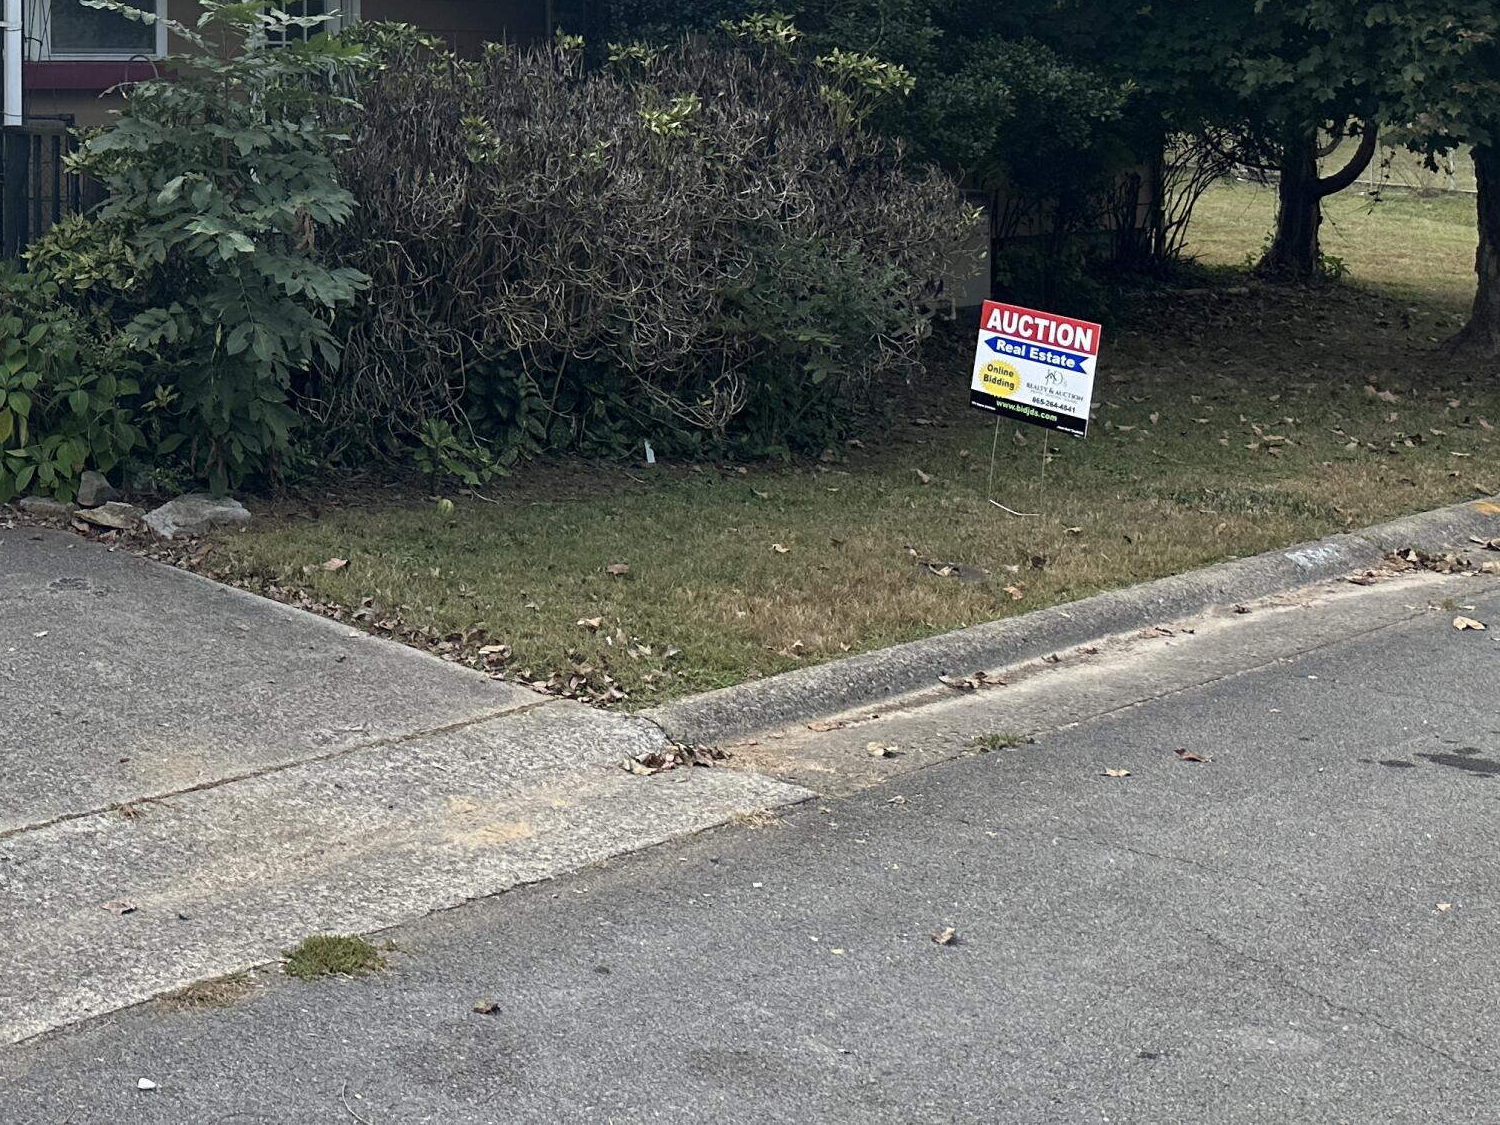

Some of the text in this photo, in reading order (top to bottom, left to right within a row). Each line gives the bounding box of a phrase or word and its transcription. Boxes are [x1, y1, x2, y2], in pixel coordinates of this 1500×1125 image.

[986, 308, 1093, 352] AUCTION
[995, 339, 1076, 368] Real Estate
[987, 363, 1015, 378] Online
[982, 374, 1016, 391] Bidding
[996, 399, 1058, 422] www.bidjds.com
